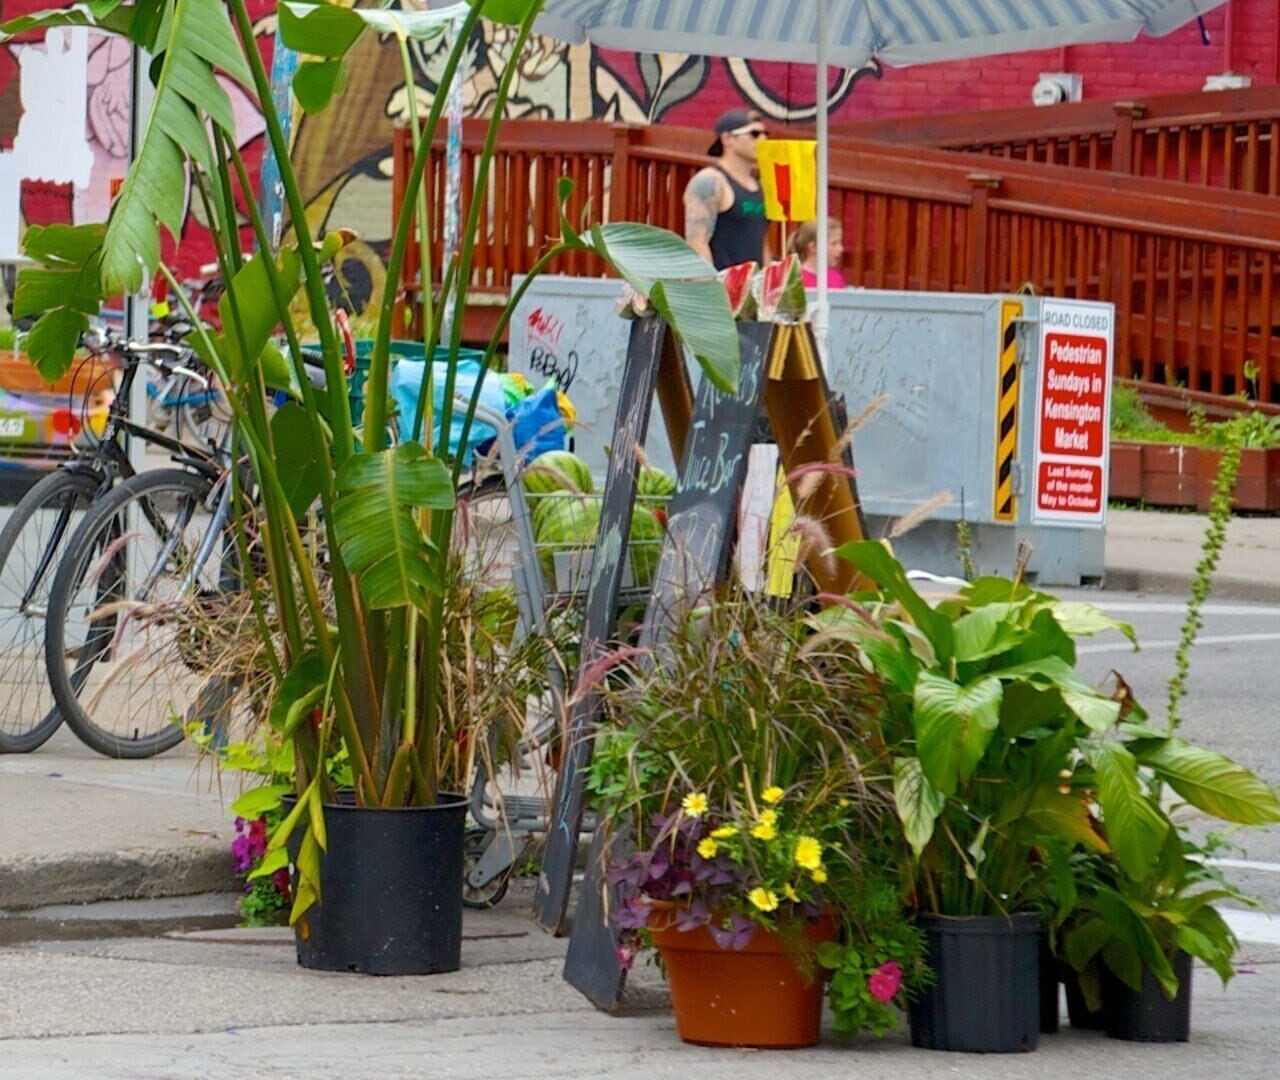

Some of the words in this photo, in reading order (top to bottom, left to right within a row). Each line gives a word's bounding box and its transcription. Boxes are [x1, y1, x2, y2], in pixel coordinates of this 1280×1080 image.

[1045, 311, 1071, 328] ROAD
[1073, 313, 1109, 331] CLOSED
[1050, 339, 1102, 365] Pedestrian
[1047, 368, 1090, 398] Sundays
[1092, 373, 1102, 393] in
[1045, 397, 1101, 426] Kensington
[1055, 427, 1089, 451] Market
[1047, 465, 1064, 478] Last
[1065, 466, 1093, 481] Sunday
[1046, 480, 1055, 491] of
[1056, 480, 1068, 493] the
[1069, 481, 1093, 493] month
[1041, 494, 1057, 508] May
[1058, 495, 1067, 507] to
[1067, 495, 1098, 509] October
